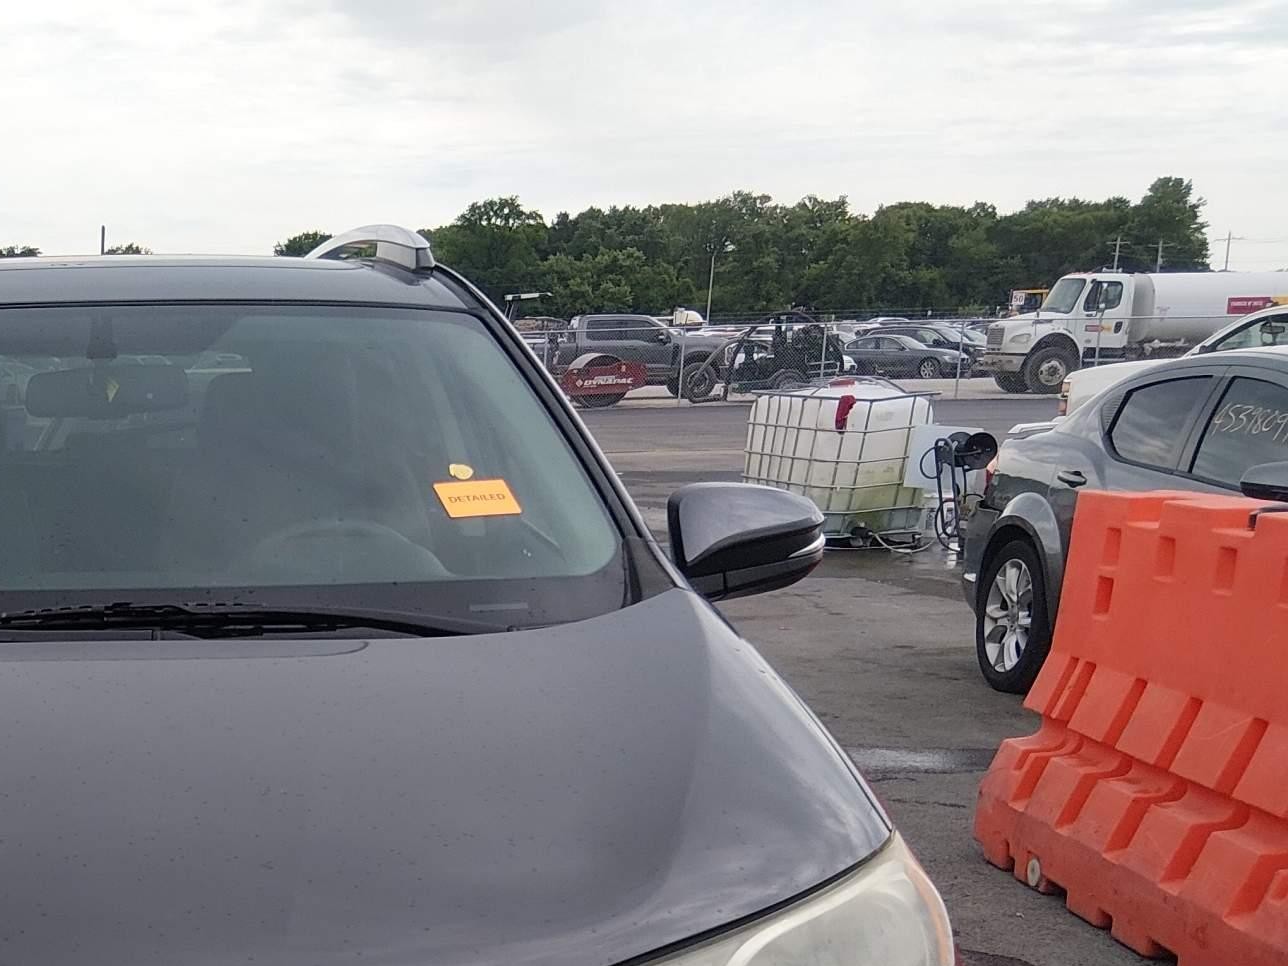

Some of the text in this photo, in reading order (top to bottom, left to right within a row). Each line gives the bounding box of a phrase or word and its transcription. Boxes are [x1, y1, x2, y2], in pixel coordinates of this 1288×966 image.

[1013, 294, 1024, 303] 50
[1211, 402, 1288, 442] 4539809
[447, 493, 506, 504] DETAILED
